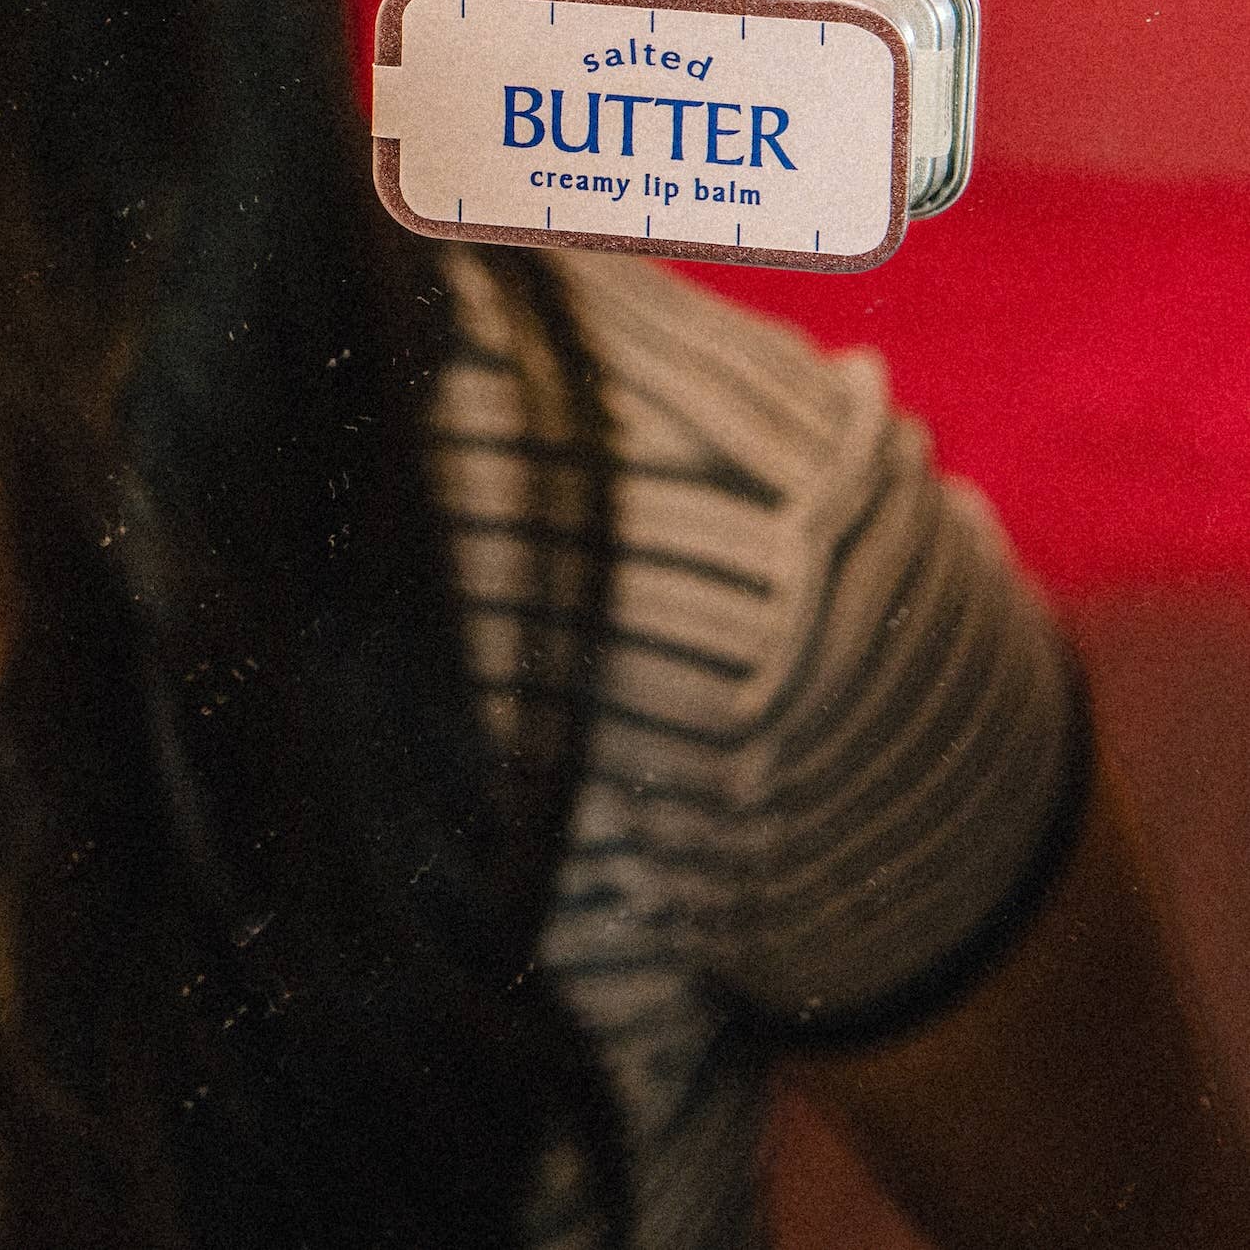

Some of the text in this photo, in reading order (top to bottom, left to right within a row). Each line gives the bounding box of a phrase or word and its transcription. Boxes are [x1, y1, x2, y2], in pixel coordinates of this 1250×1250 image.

[583, 38, 713, 81] salted
[503, 85, 798, 170] BUTTER
[530, 170, 761, 206] creamy lip balm
